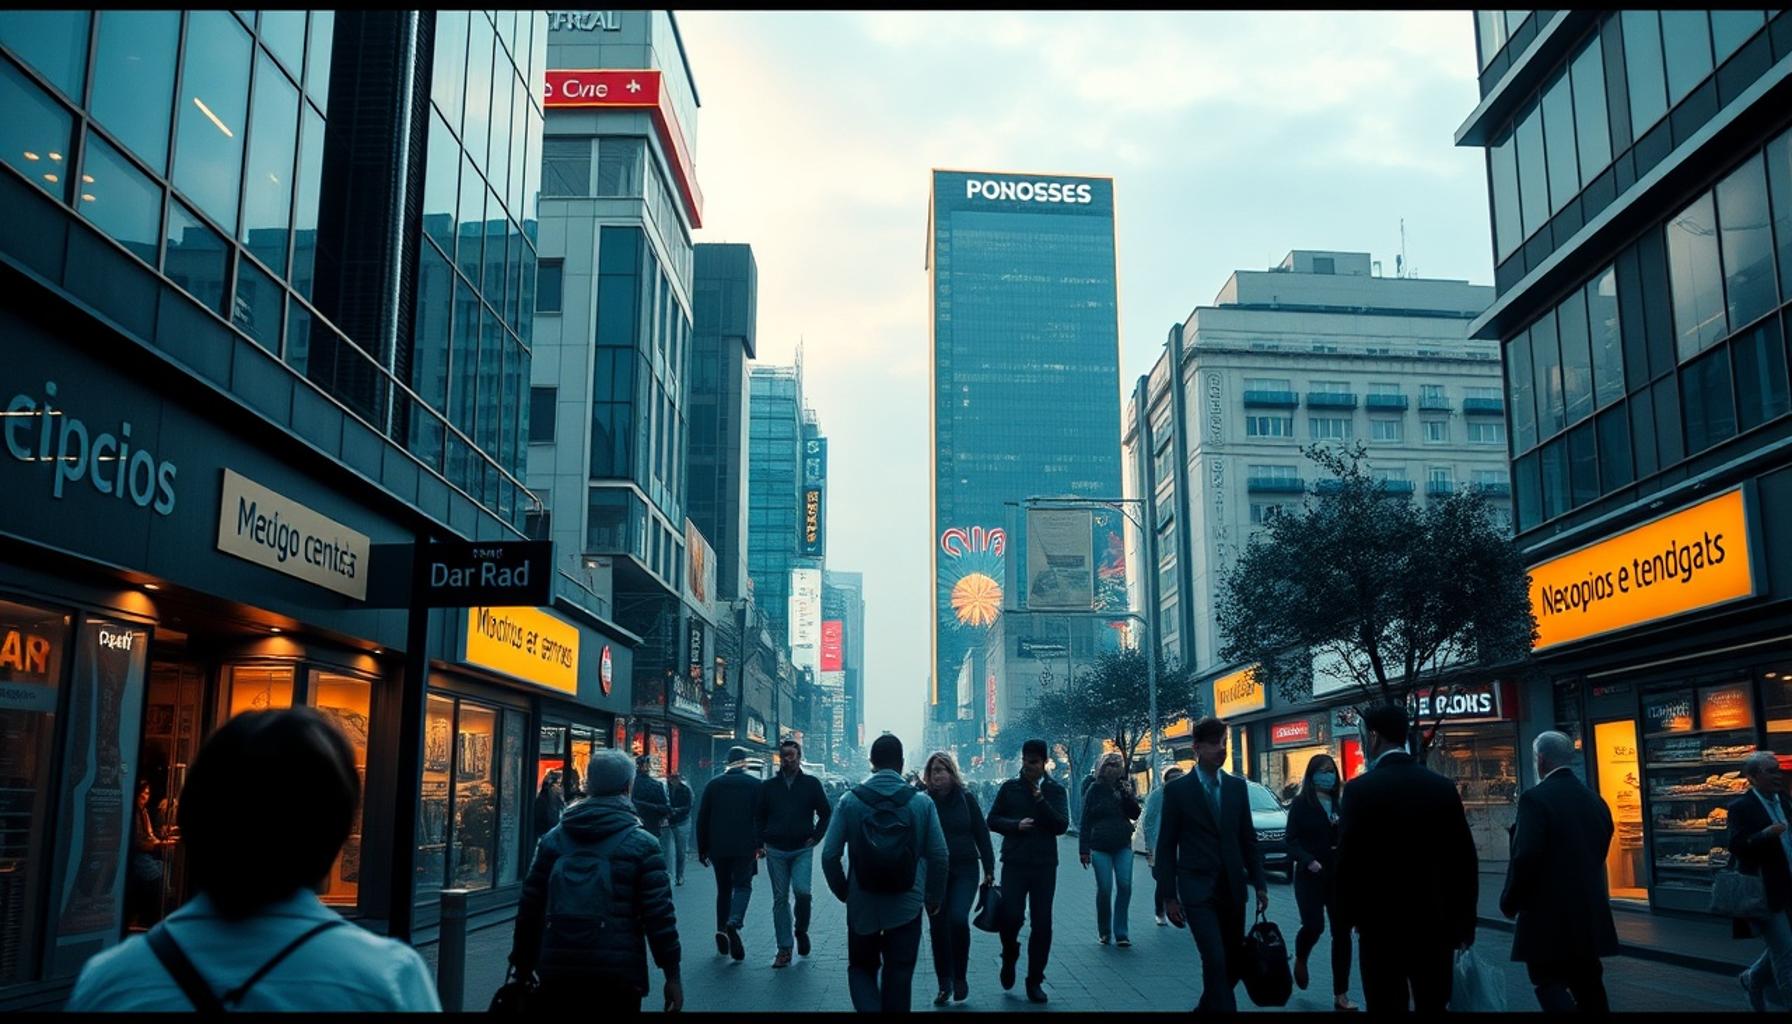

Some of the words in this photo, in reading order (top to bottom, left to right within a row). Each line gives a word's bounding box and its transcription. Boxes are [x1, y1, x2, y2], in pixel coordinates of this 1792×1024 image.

[966, 179, 1092, 203] PONOSSES
[431, 562, 475, 587] Dar
[481, 560, 530, 587] Rad
[1618, 566, 1629, 593] e
